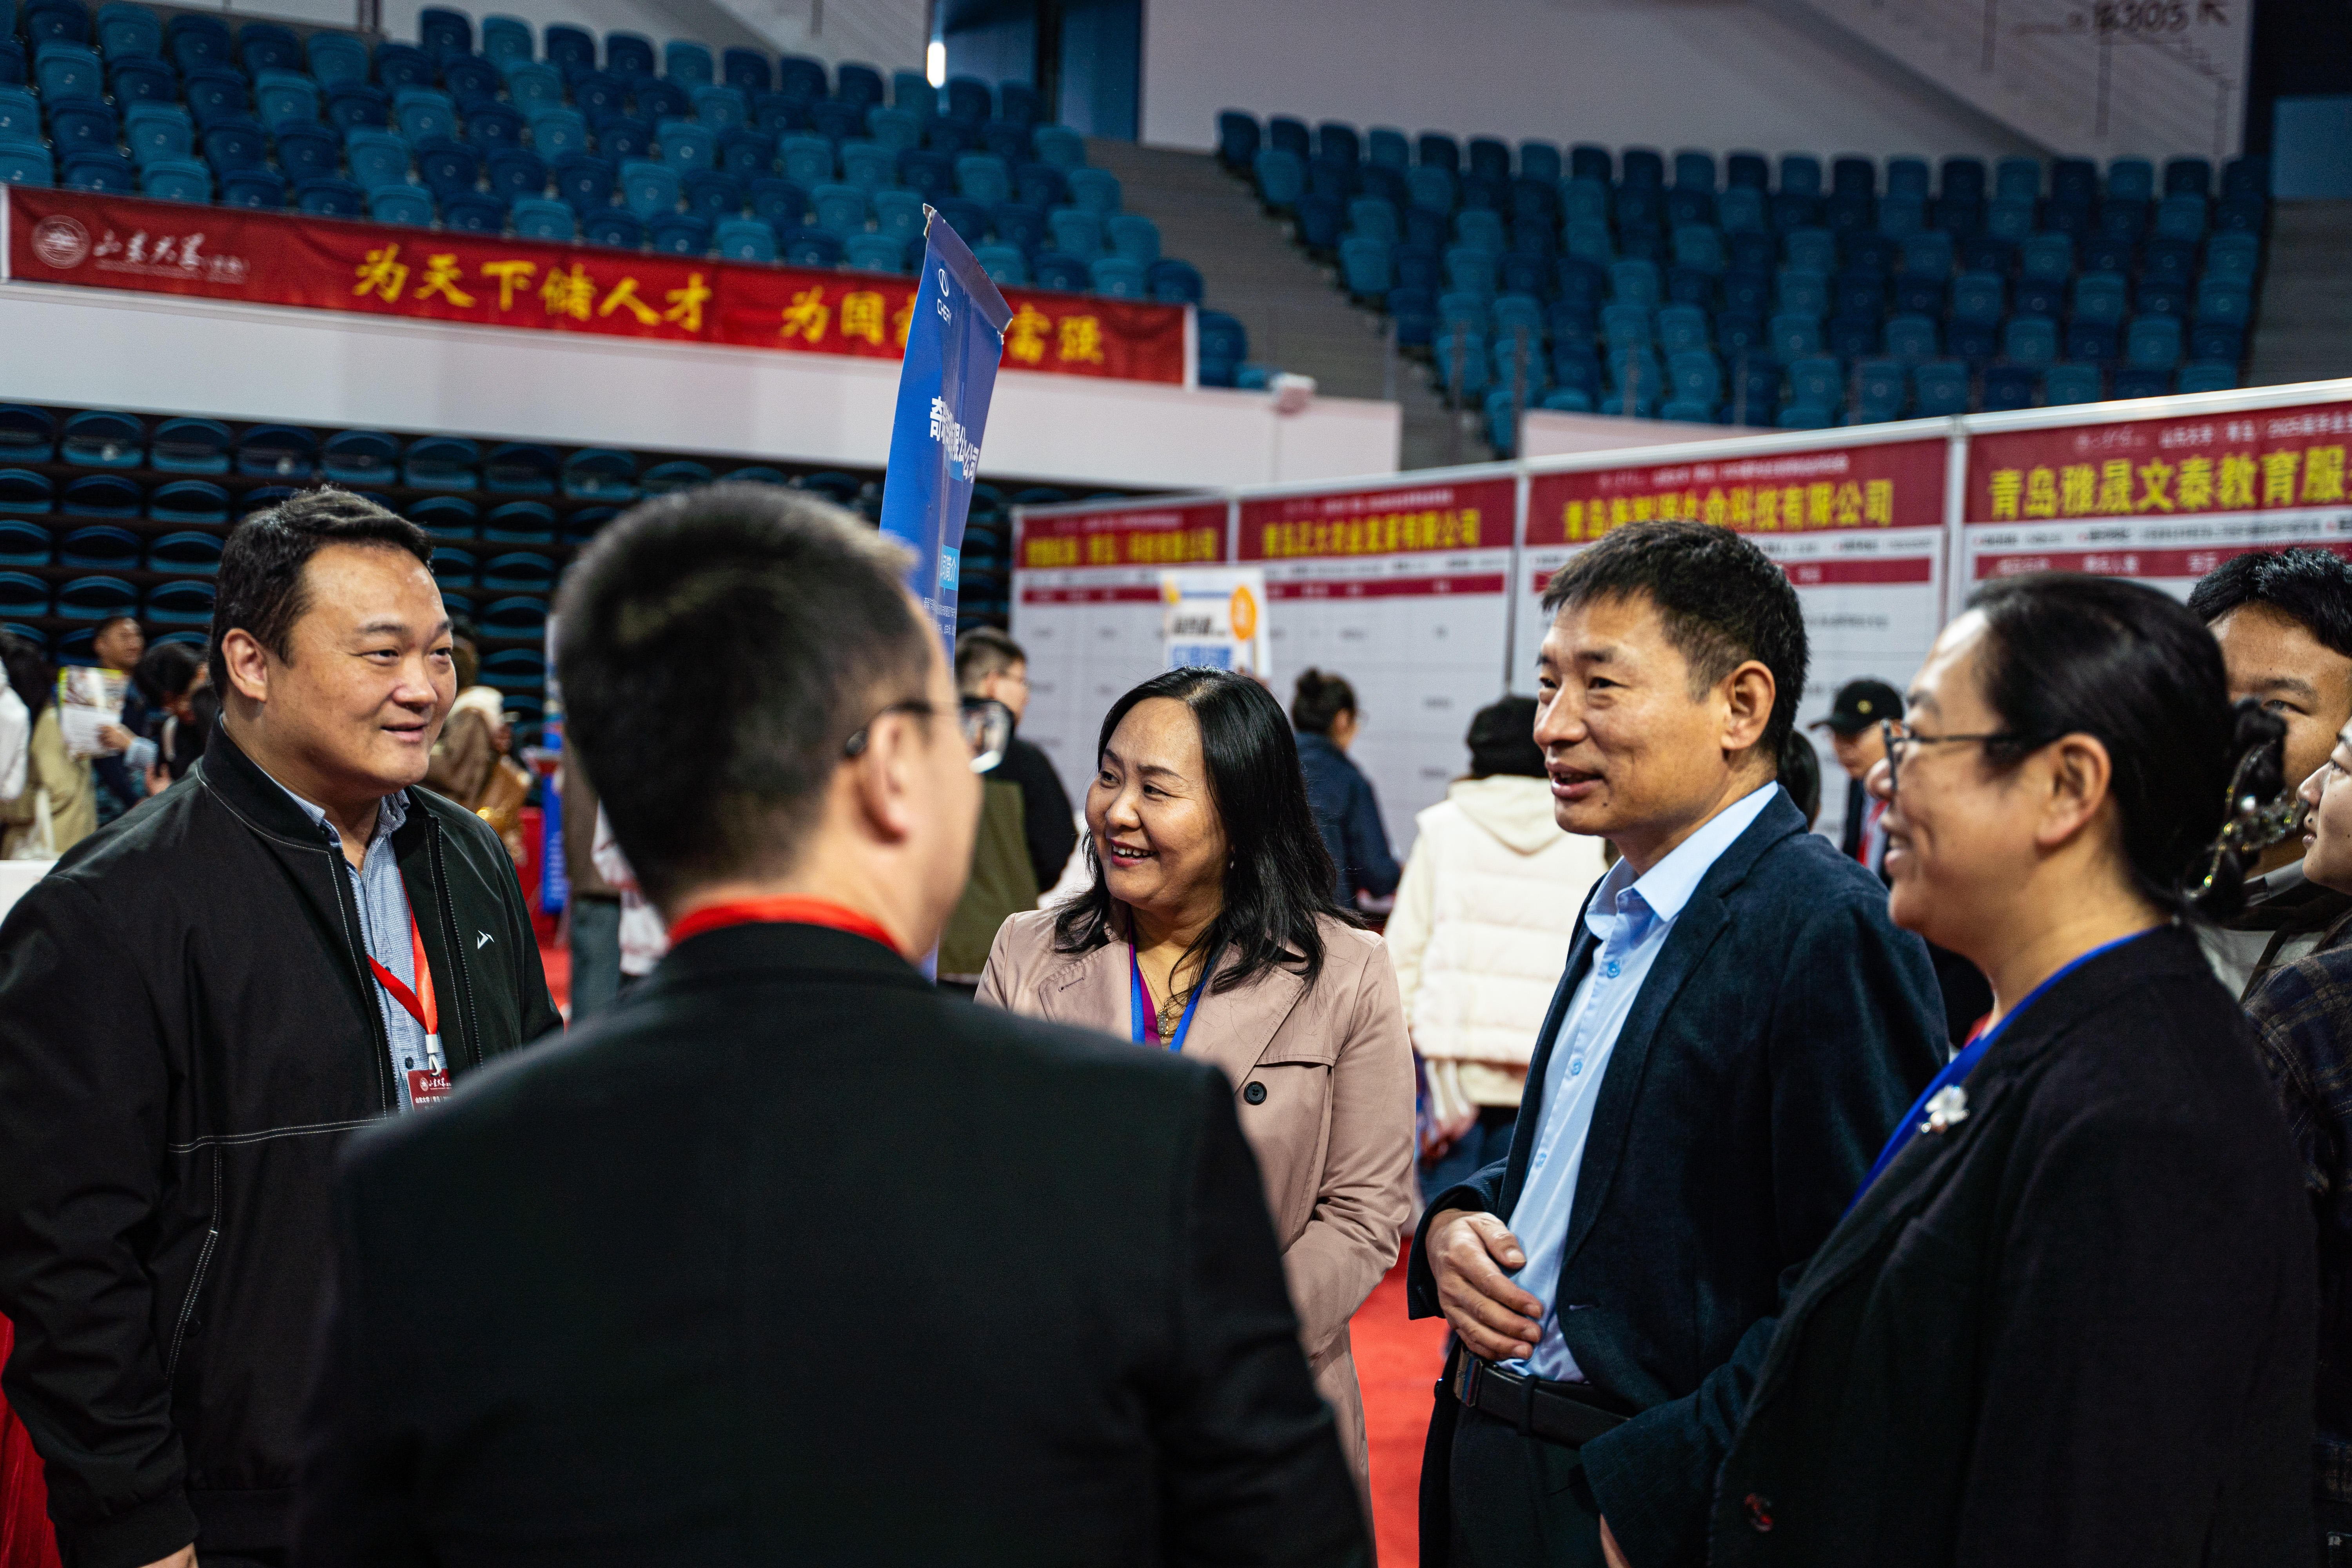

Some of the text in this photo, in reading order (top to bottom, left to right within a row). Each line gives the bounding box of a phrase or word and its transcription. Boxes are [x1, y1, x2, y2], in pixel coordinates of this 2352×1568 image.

[352, 243, 1104, 364] 为天下储人才 为国富强
[937, 298, 951, 327] CHERY
[1989, 444, 2352, 521] 青岛雅晟文泰教育服
